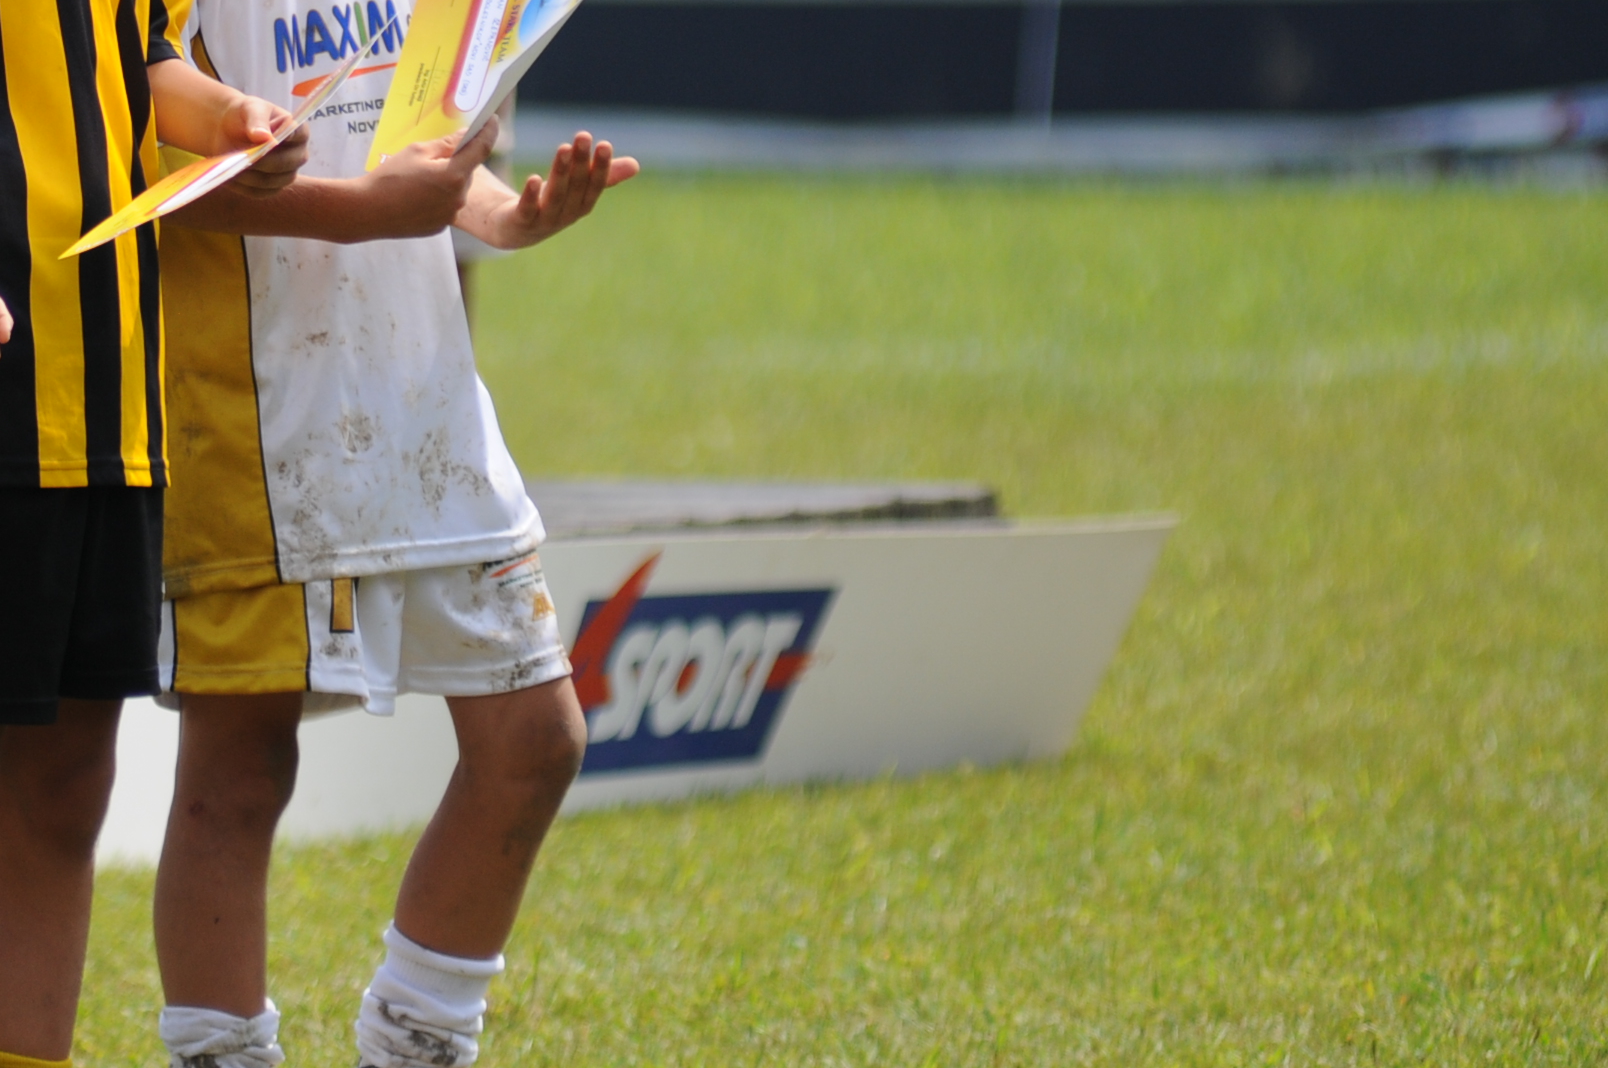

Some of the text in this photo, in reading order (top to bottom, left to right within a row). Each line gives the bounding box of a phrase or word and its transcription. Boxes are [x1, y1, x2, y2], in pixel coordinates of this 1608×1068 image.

[504, 3, 521, 34] STARS
[496, 35, 512, 64] TEAM
[307, 97, 385, 122] ARKETING
